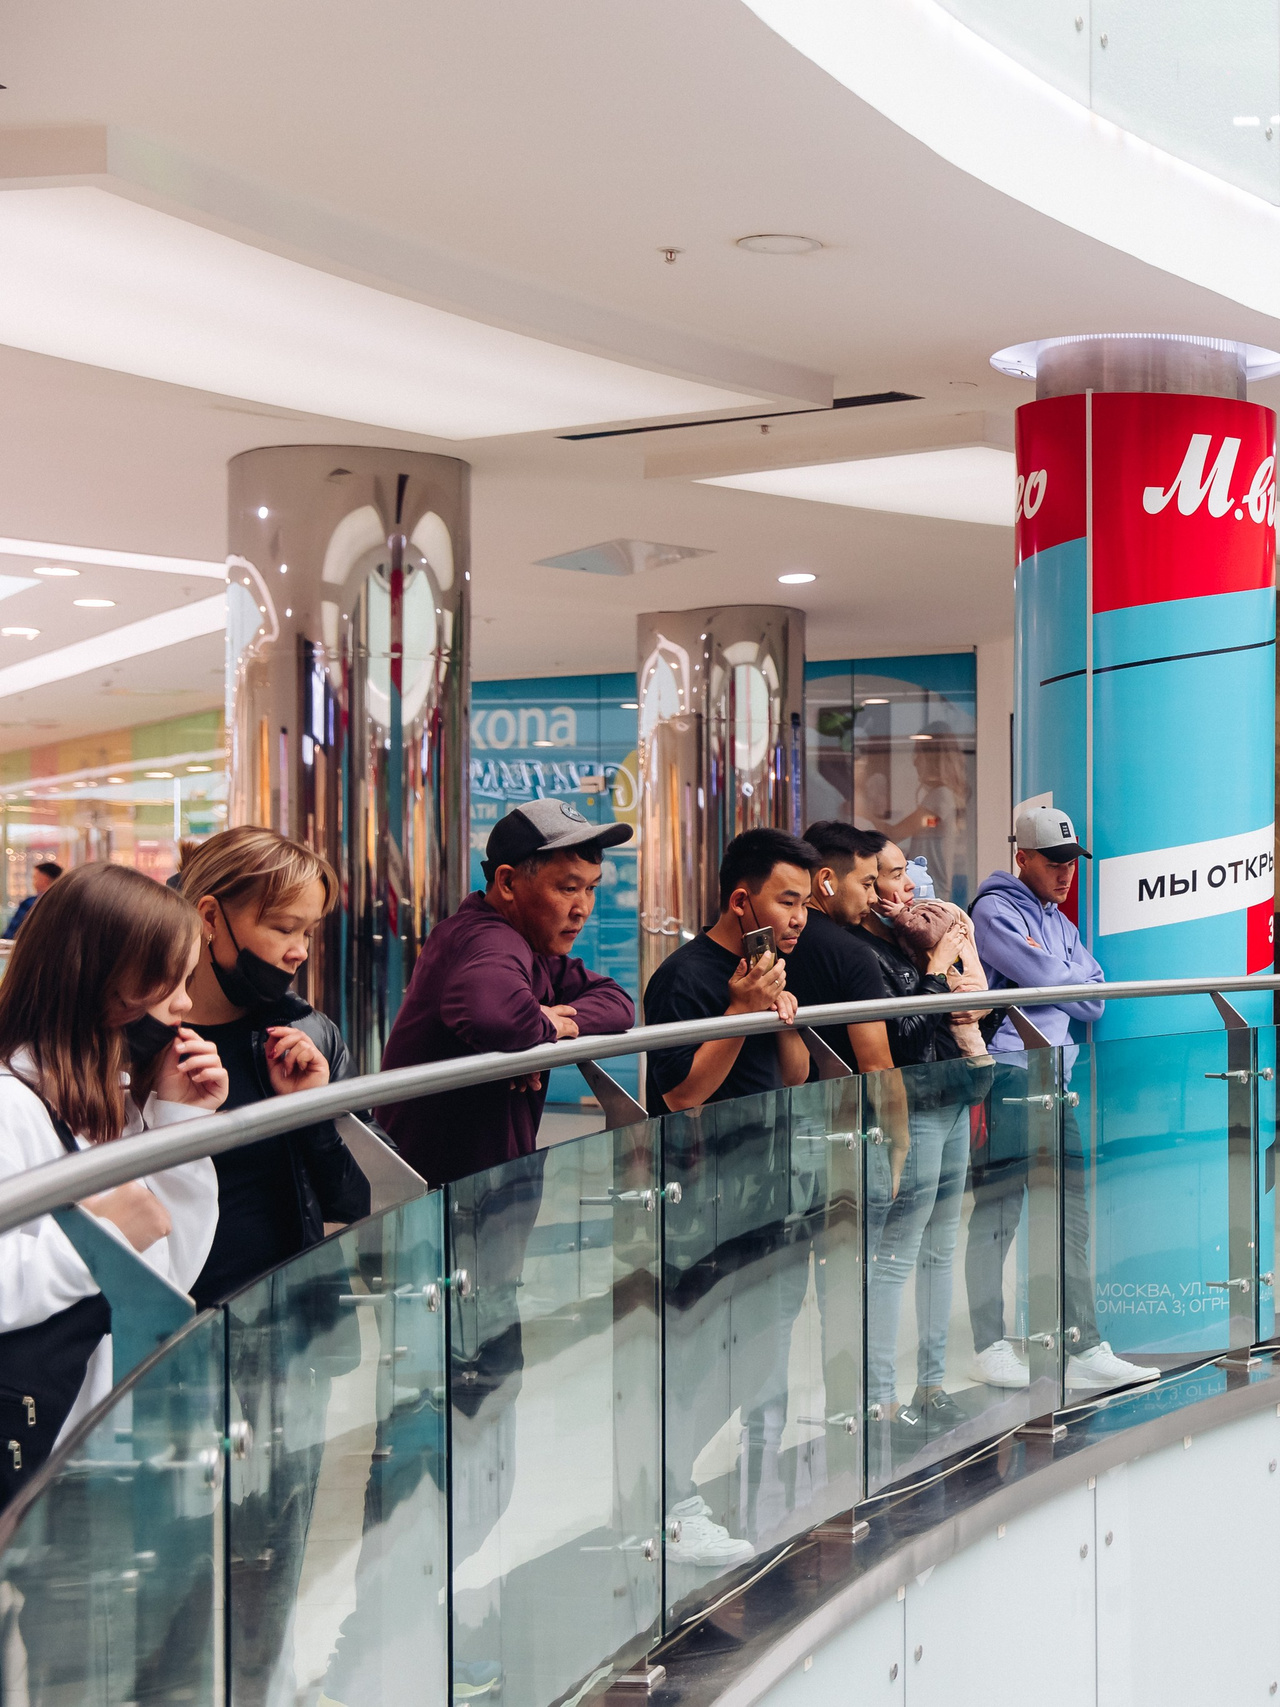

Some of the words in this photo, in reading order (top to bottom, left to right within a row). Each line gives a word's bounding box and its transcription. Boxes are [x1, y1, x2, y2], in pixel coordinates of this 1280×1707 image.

[1138, 869, 1197, 902] МЫ
[1096, 1283, 1175, 1299] МОСКВА,
[1179, 1282, 1205, 1296] УЛ.
[1172, 1300, 1186, 1317] 3;
